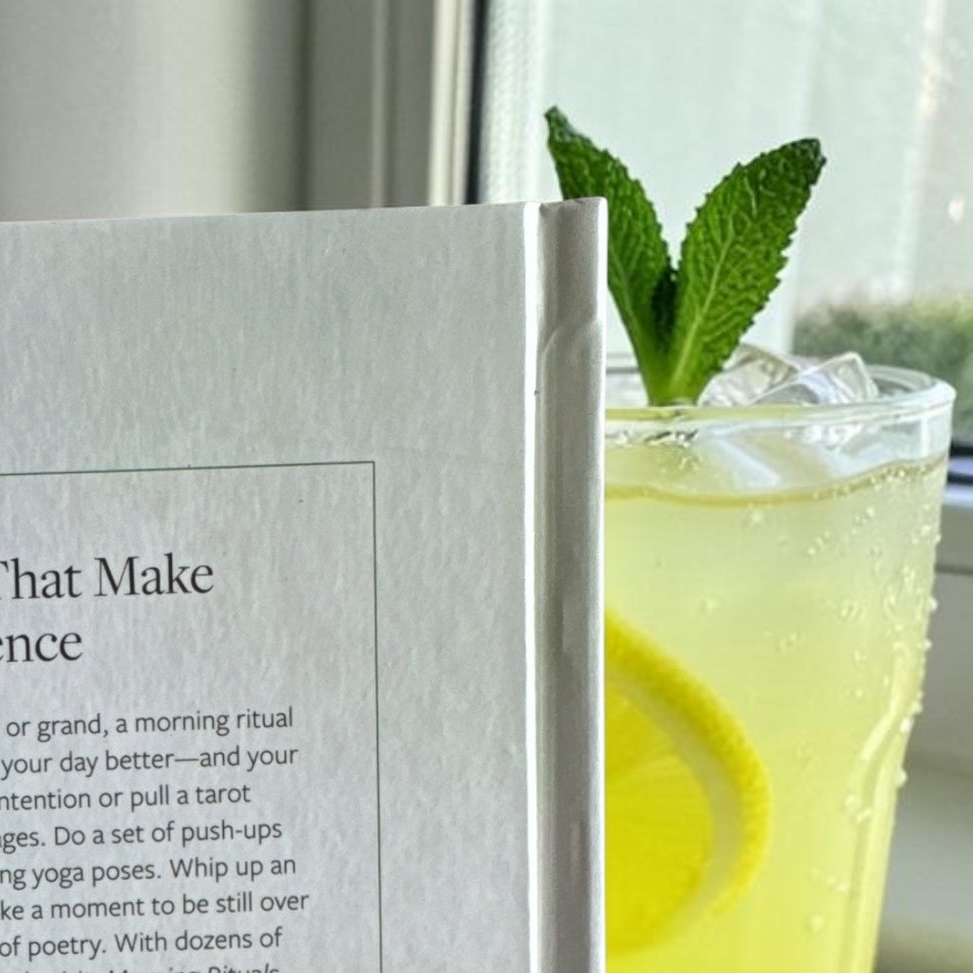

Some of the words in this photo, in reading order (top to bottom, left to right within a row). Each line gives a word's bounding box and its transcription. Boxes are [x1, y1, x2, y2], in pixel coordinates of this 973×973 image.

[94, 552, 214, 597] Make
[6, 721, 31, 737] or
[37, 713, 109, 743] grand,
[116, 718, 128, 733] a
[135, 710, 230, 737] morning
[237, 705, 293, 729] ritual
[0, 757, 53, 781] your
[59, 750, 98, 778] day
[246, 749, 299, 773] your
[99, 792, 123, 808] or
[131, 784, 169, 813] pull
[177, 789, 189, 805] a
[195, 785, 251, 805] tarot
[54, 826, 86, 846] Do
[92, 829, 105, 845] a
[111, 825, 145, 844] set
[151, 820, 175, 843] of
[182, 819, 282, 848] push-ups
[31, 866, 84, 890] yoga
[92, 864, 161, 888] poses.
[169, 856, 228, 883] Whip
[236, 860, 263, 882] up
[270, 859, 296, 875] an
[31, 904, 43, 920] a
[51, 899, 145, 919] moment
[151, 898, 175, 916] to
[183, 893, 209, 915] be
[216, 891, 252, 913] still
[260, 895, 310, 912] over
[28, 937, 106, 963] poetry.
[114, 930, 167, 952] With
[175, 929, 253, 951] dozens
[259, 926, 283, 948] of
